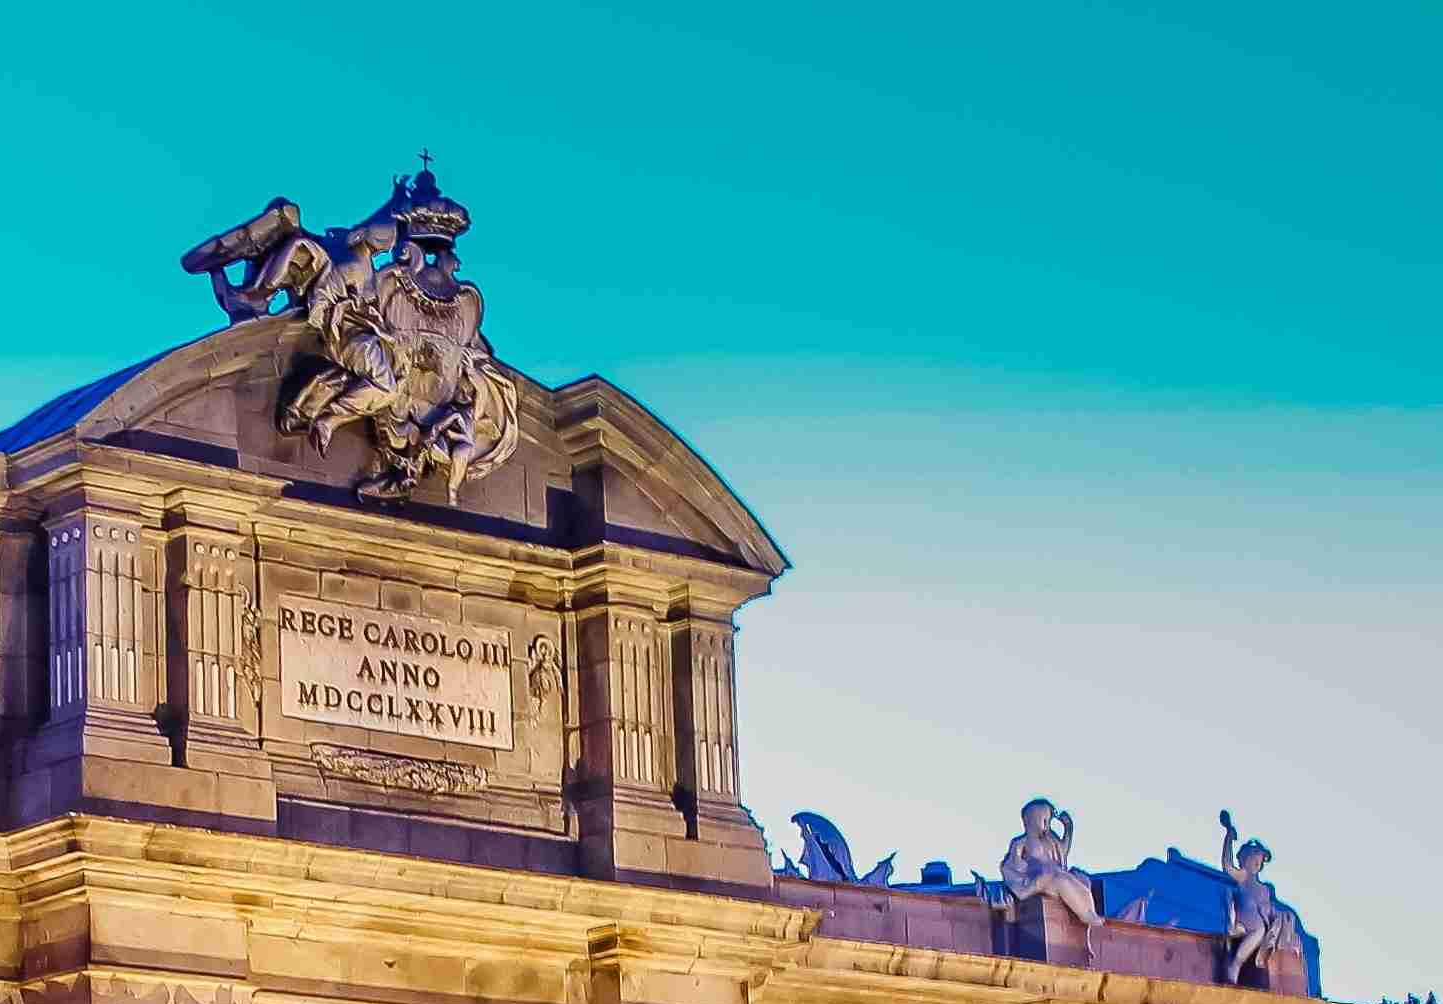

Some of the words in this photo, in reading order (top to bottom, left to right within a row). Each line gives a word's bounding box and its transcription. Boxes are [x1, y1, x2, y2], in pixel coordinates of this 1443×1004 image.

[280, 607, 354, 640] REGE
[363, 622, 473, 660] CAROLO
[481, 642, 509, 667] III
[356, 656, 440, 688] ANNO
[297, 681, 496, 735] MDCCLXXVIII
